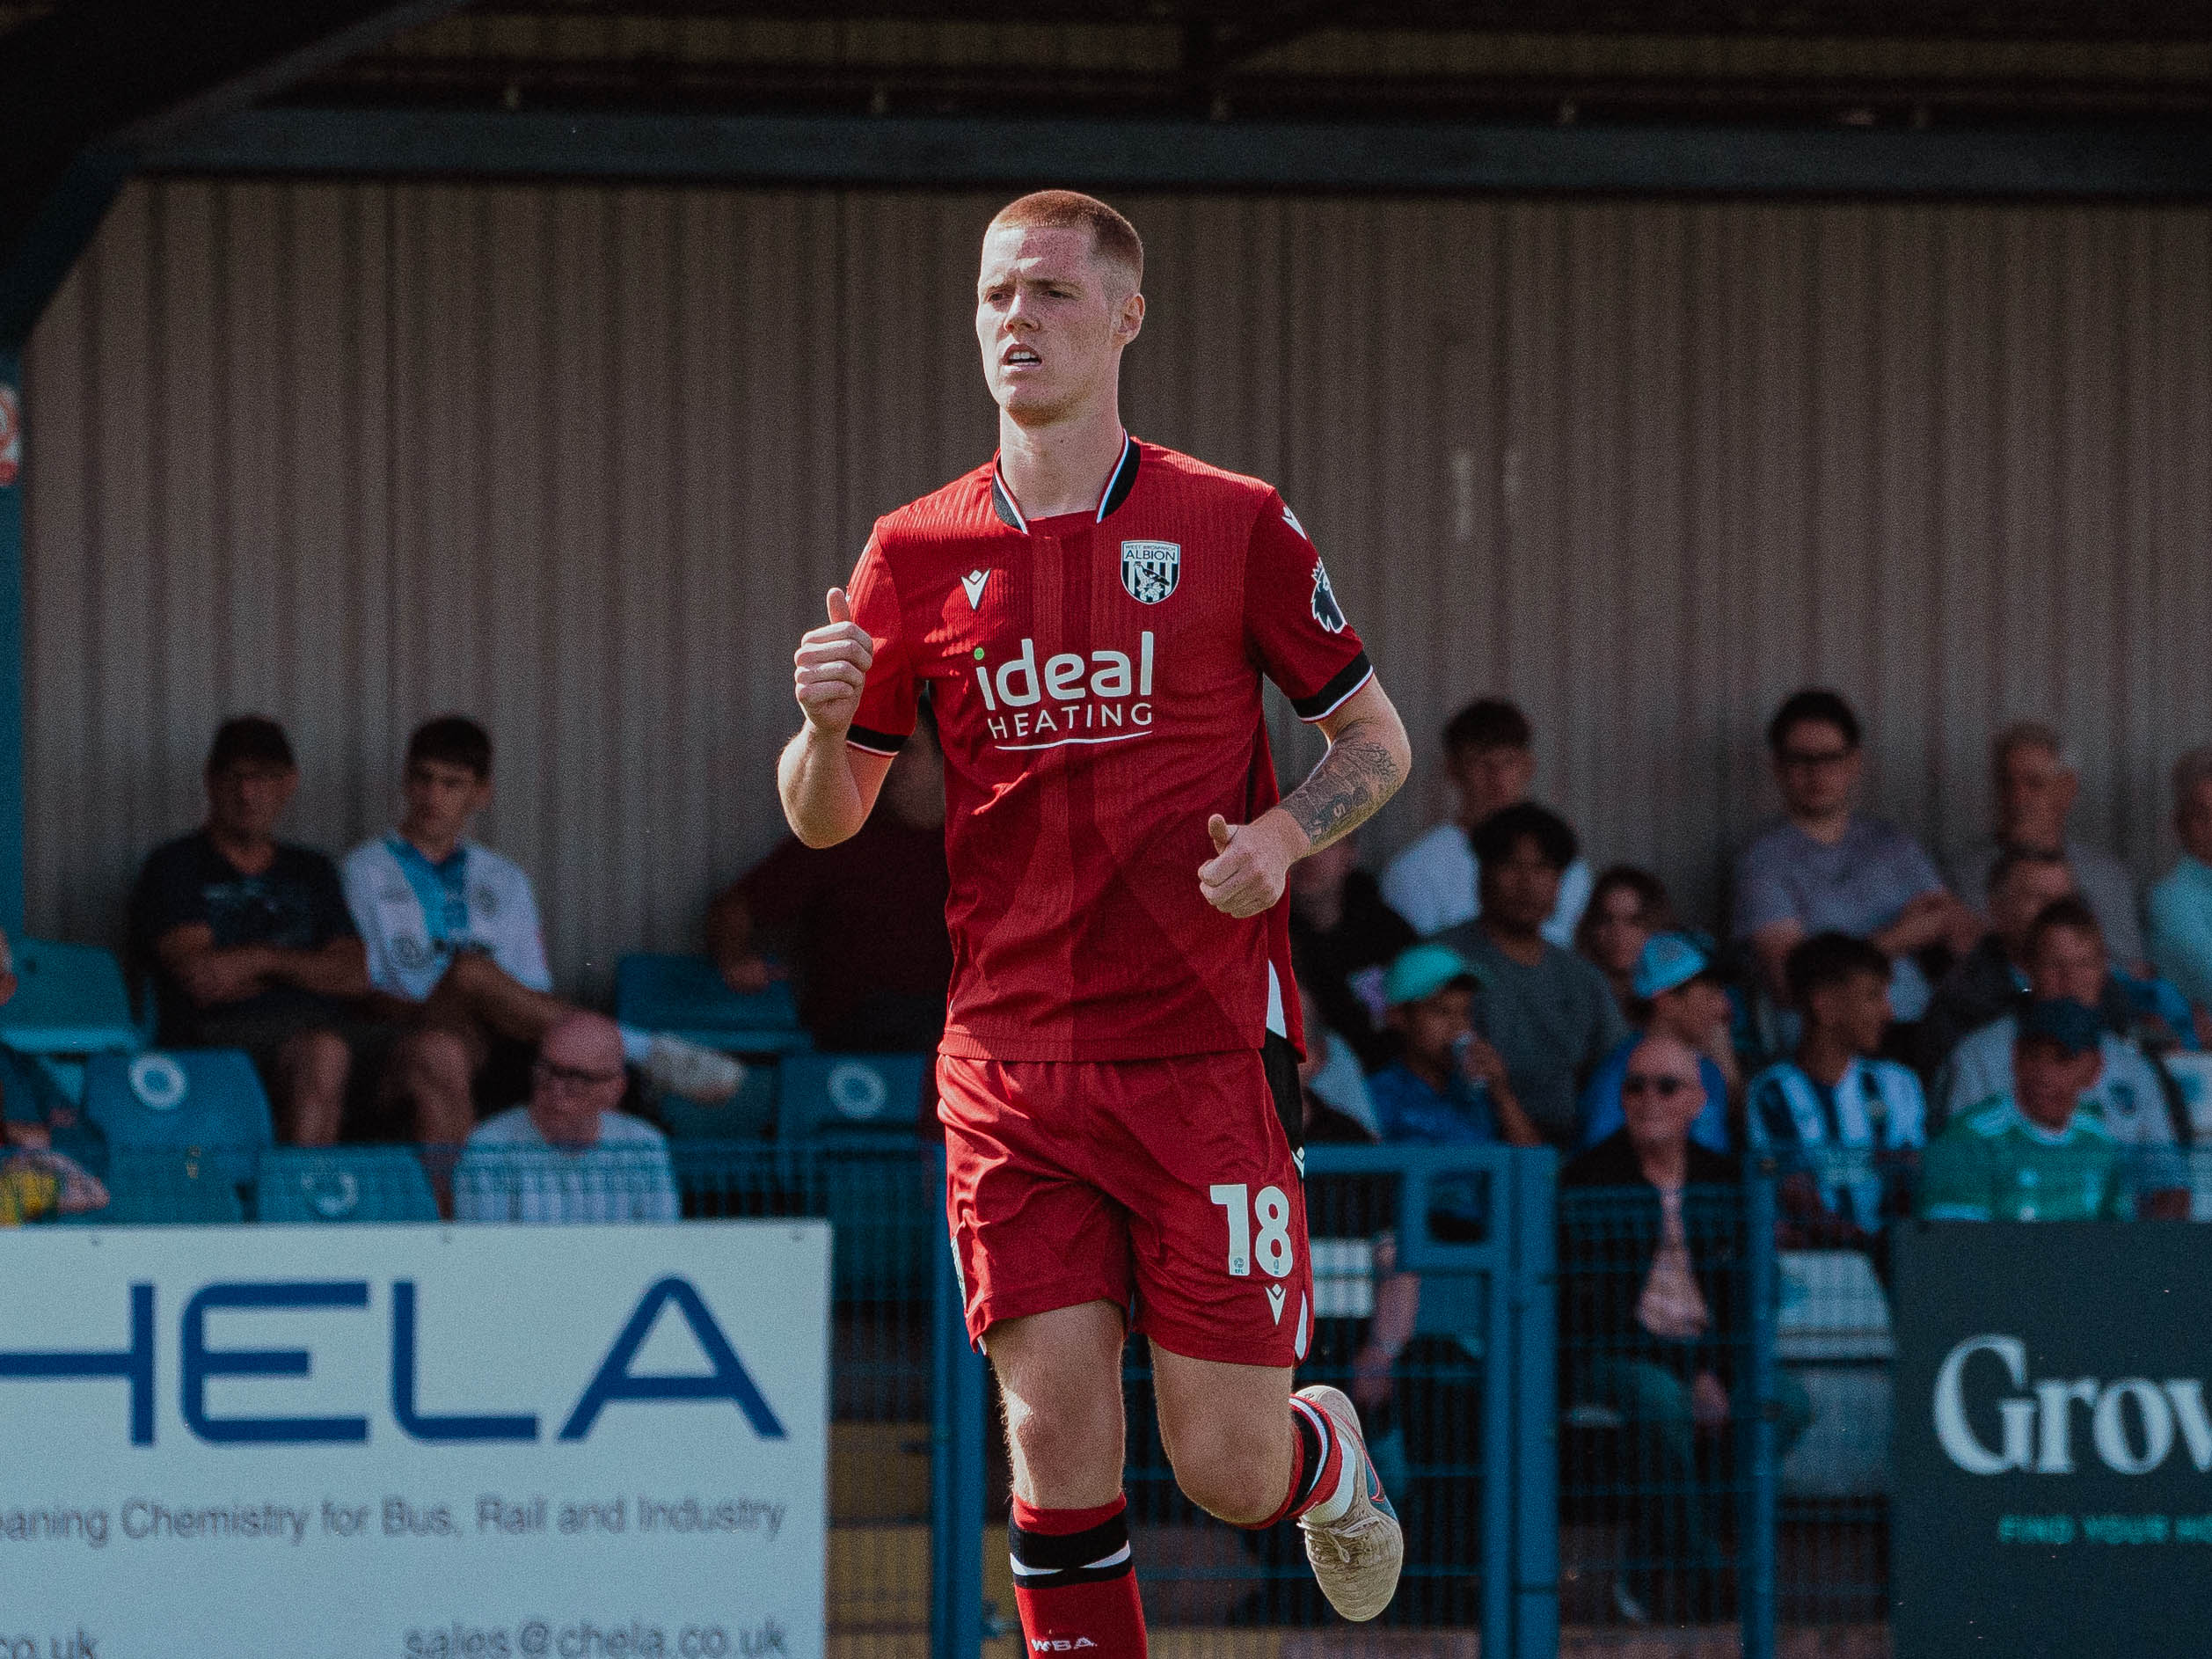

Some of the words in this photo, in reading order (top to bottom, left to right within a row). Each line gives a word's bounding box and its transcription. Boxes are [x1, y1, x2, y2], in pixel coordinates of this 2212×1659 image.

[1125, 550, 1176, 561] ALBION
[974, 631, 1154, 711] ideal
[987, 703, 1153, 740] HEATING
[1209, 1184, 1293, 1277] 18
[0, 1501, 109, 1548] aning
[120, 1498, 310, 1546] Chemistry
[322, 1499, 369, 1537] for
[476, 1495, 547, 1534] Rail
[557, 1495, 625, 1534] and
[639, 1495, 785, 1542] Industry
[1031, 1637, 1095, 1651] WBA
